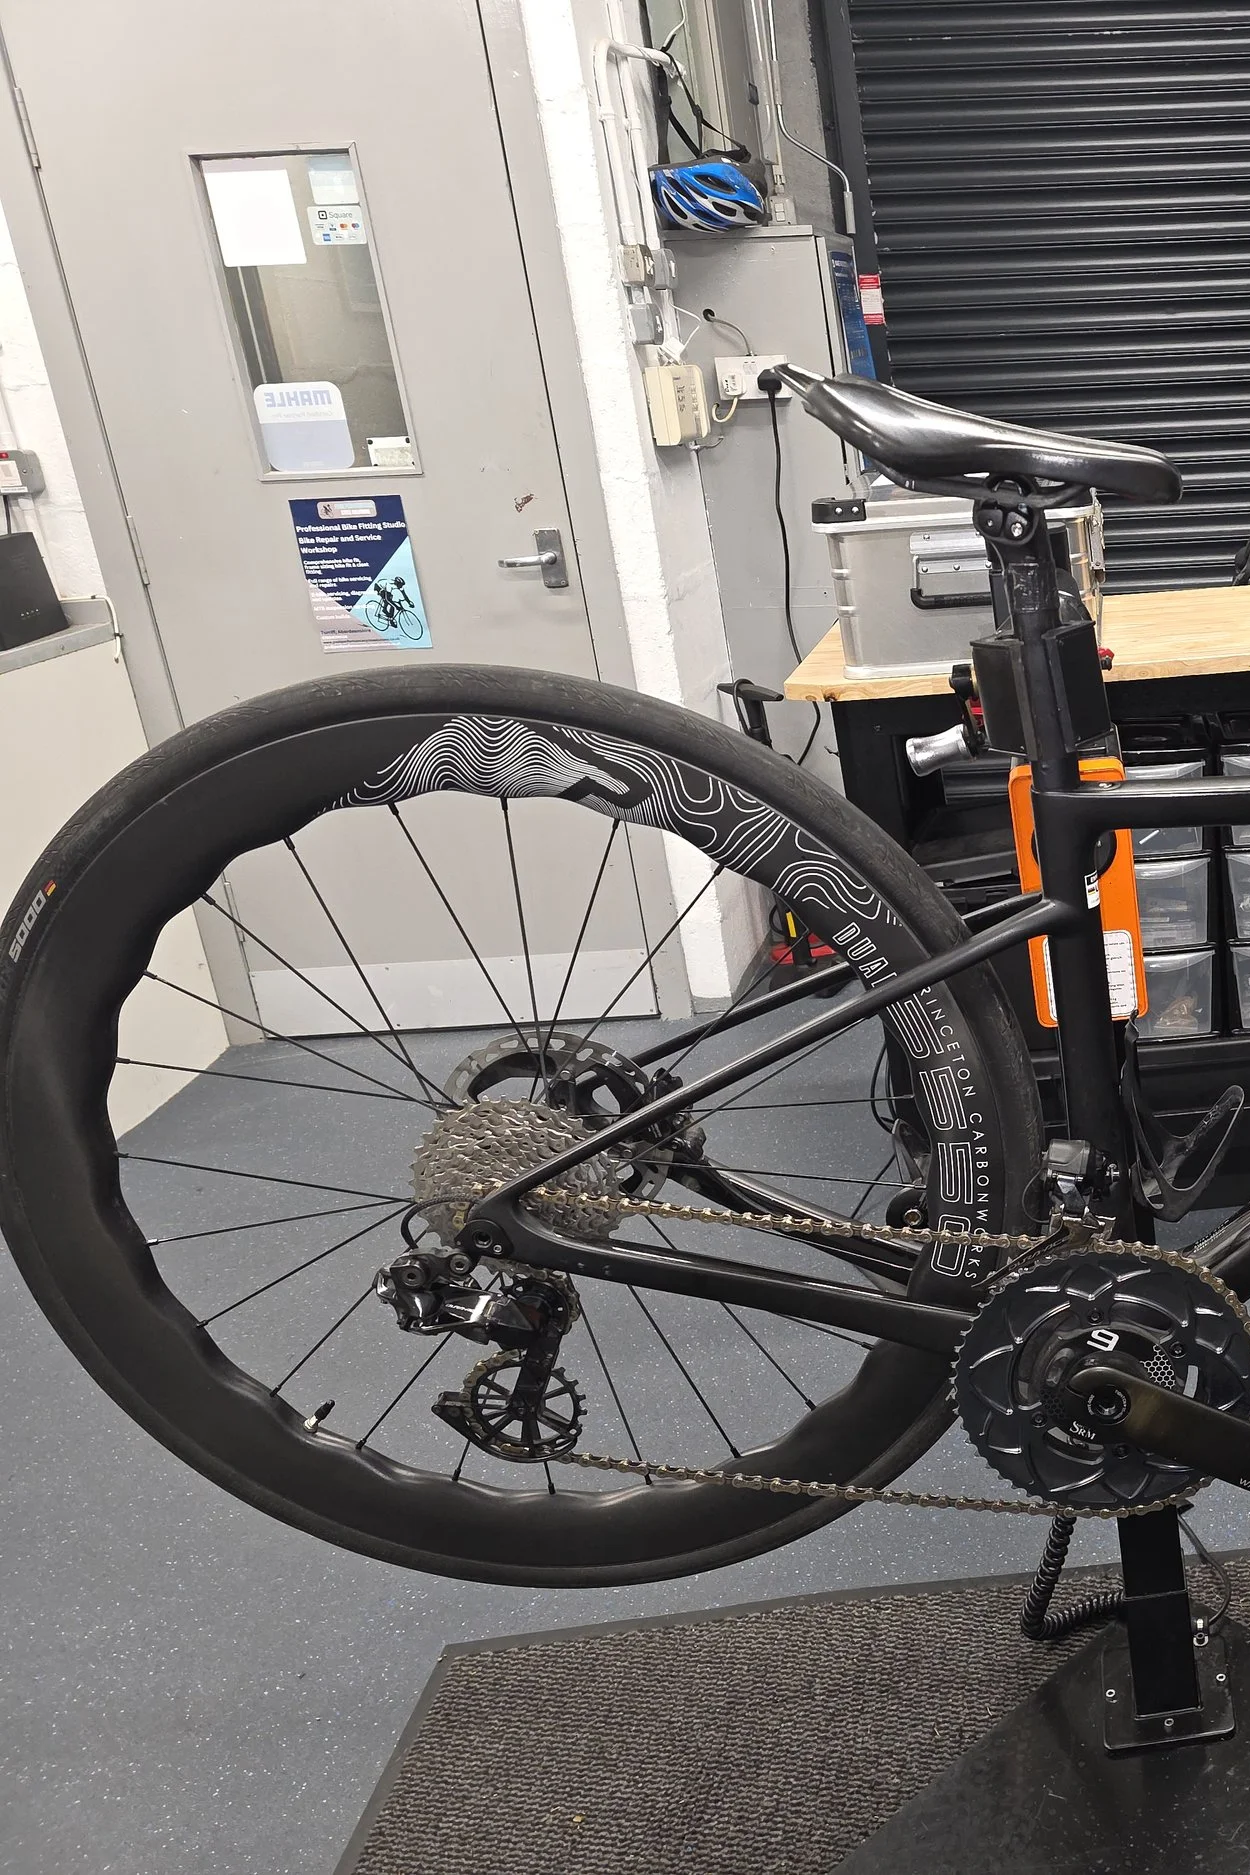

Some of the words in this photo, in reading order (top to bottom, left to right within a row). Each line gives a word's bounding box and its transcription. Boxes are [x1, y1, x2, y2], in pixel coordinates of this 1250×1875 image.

[329, 211, 353, 219] Square
[296, 524, 341, 533] Professional
[358, 522, 382, 531] Fitting
[382, 521, 406, 529] Studio
[315, 536, 339, 544] Repair
[300, 546, 338, 554] Workshop
[8, 889, 47, 963] 5000
[920, 986, 977, 1097] RINCETON
[1069, 1421, 1097, 1440] SRM
